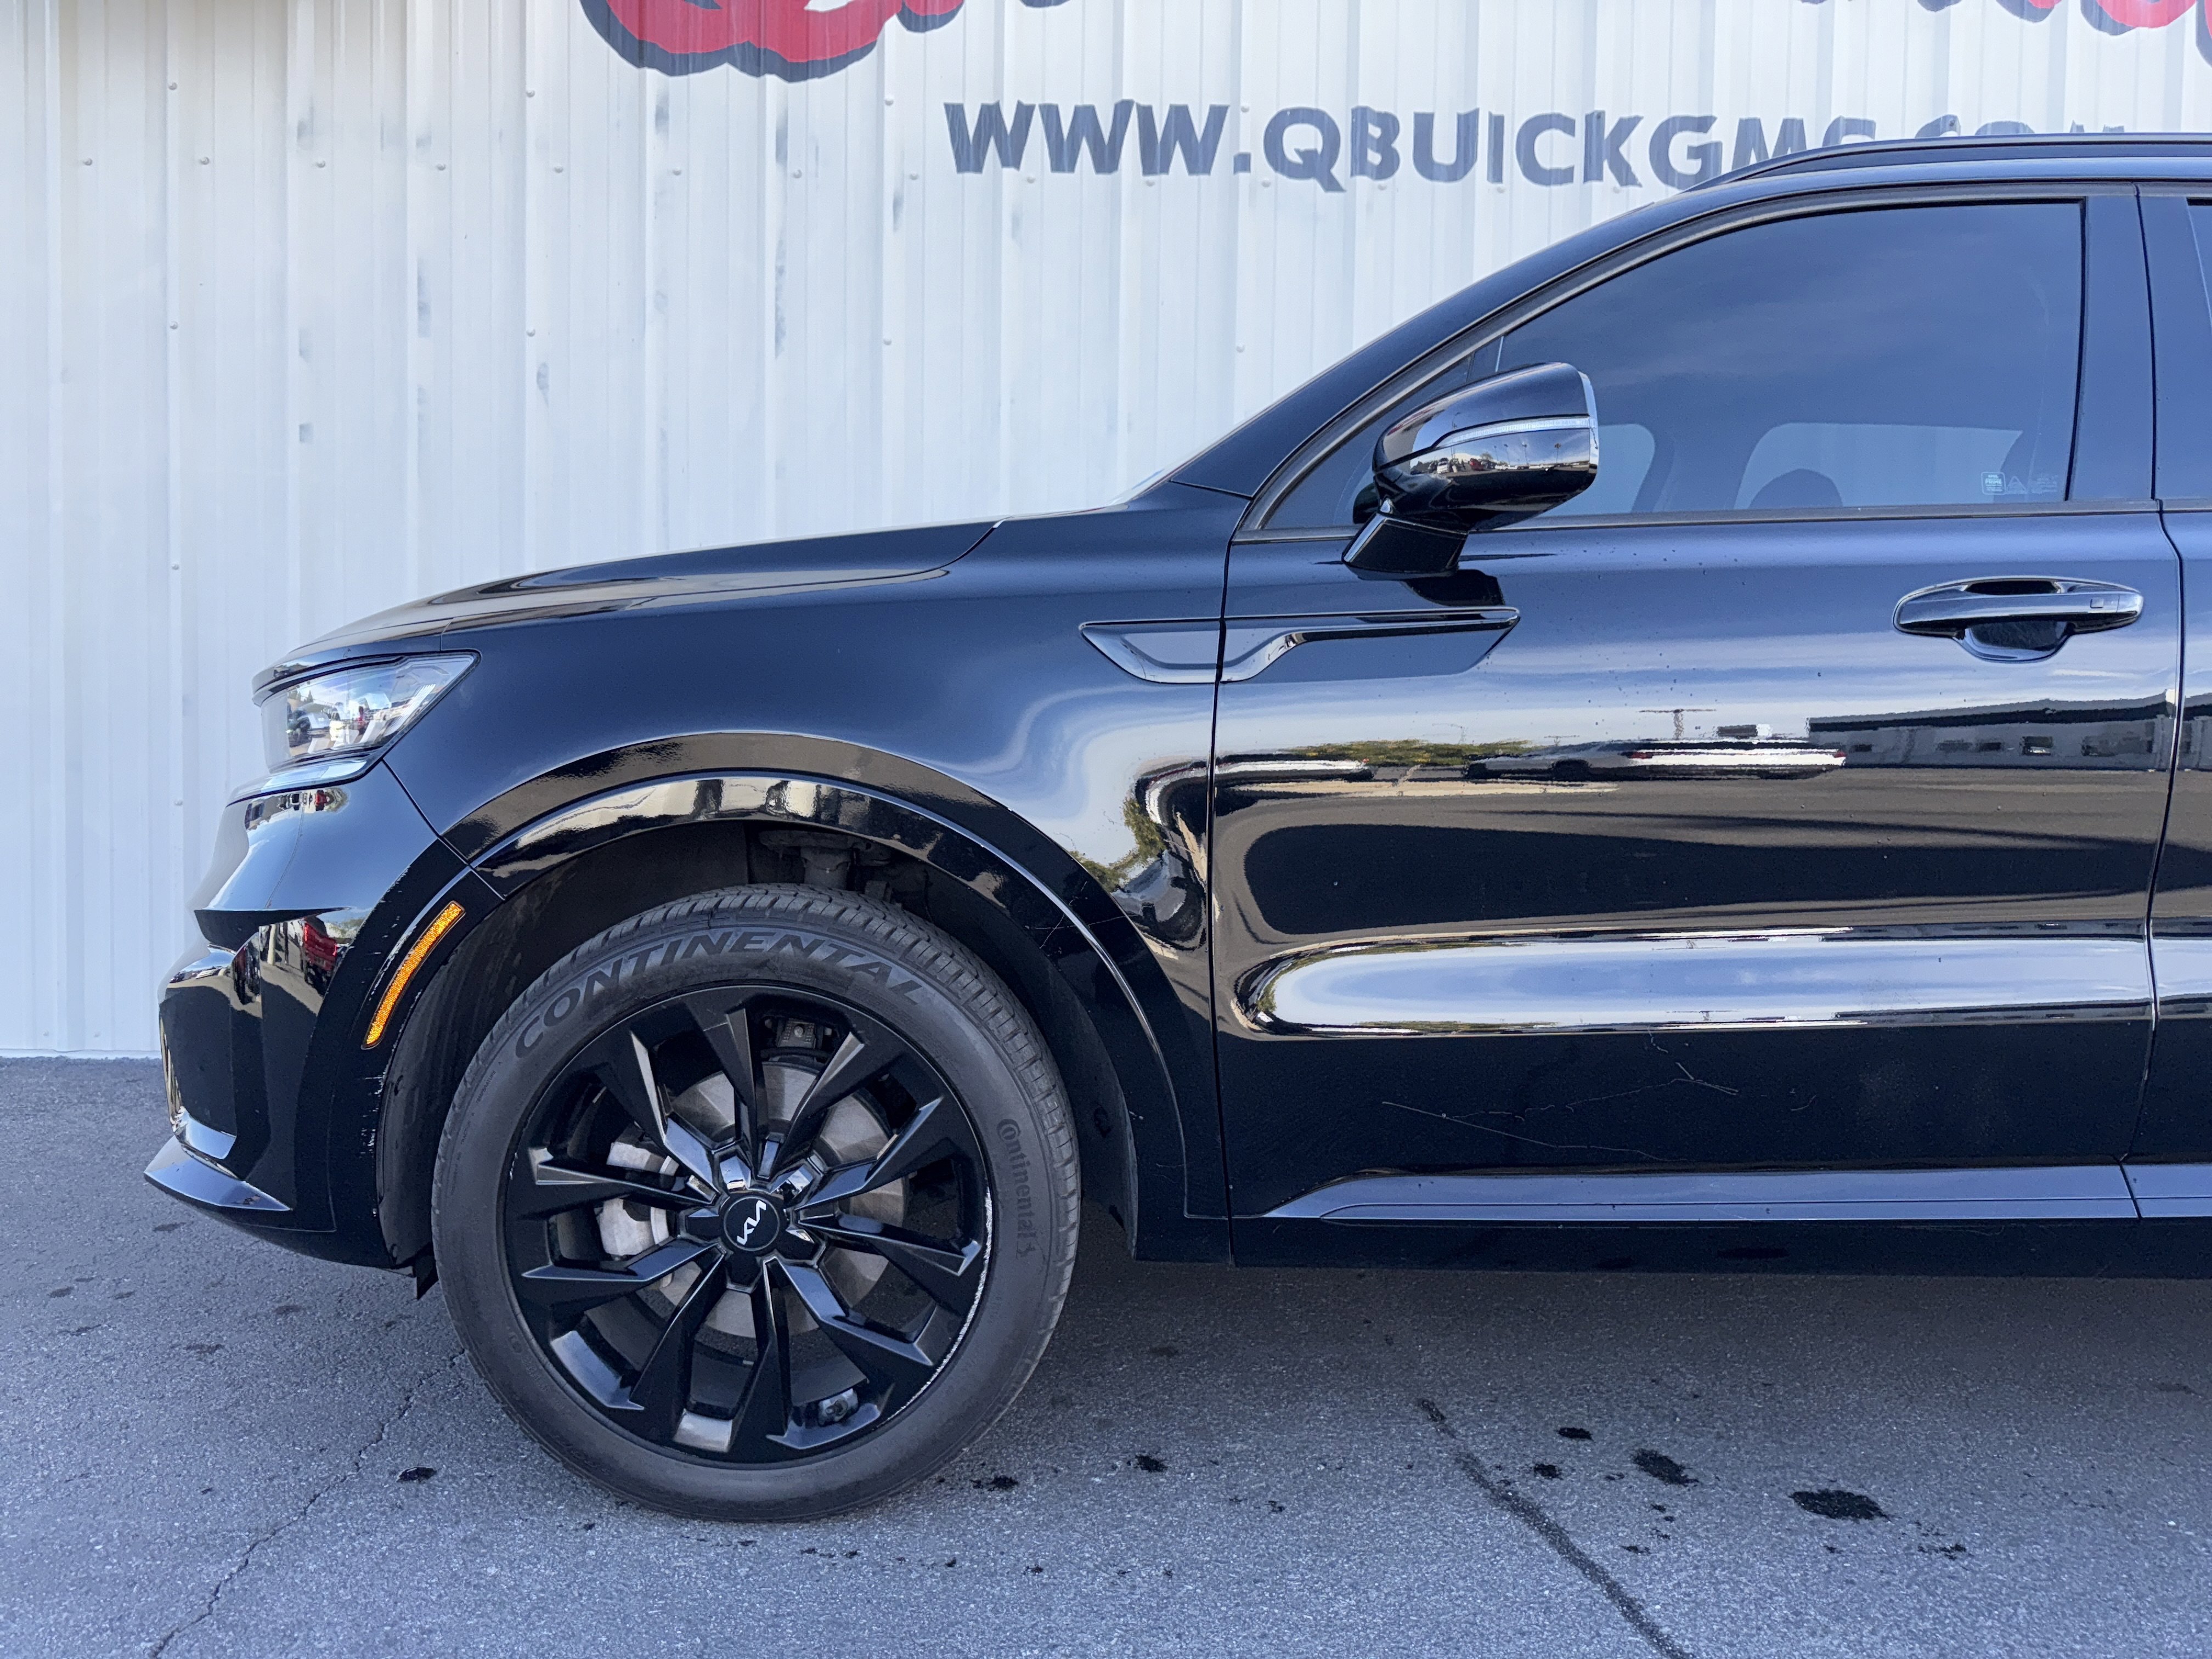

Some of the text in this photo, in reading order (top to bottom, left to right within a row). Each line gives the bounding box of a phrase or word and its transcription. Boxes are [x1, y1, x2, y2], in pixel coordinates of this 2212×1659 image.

[943, 99, 2125, 192] WWW.QBUICKGM
[515, 931, 926, 1059] CONTINENTAL
[996, 1119, 1037, 1238] Continental
